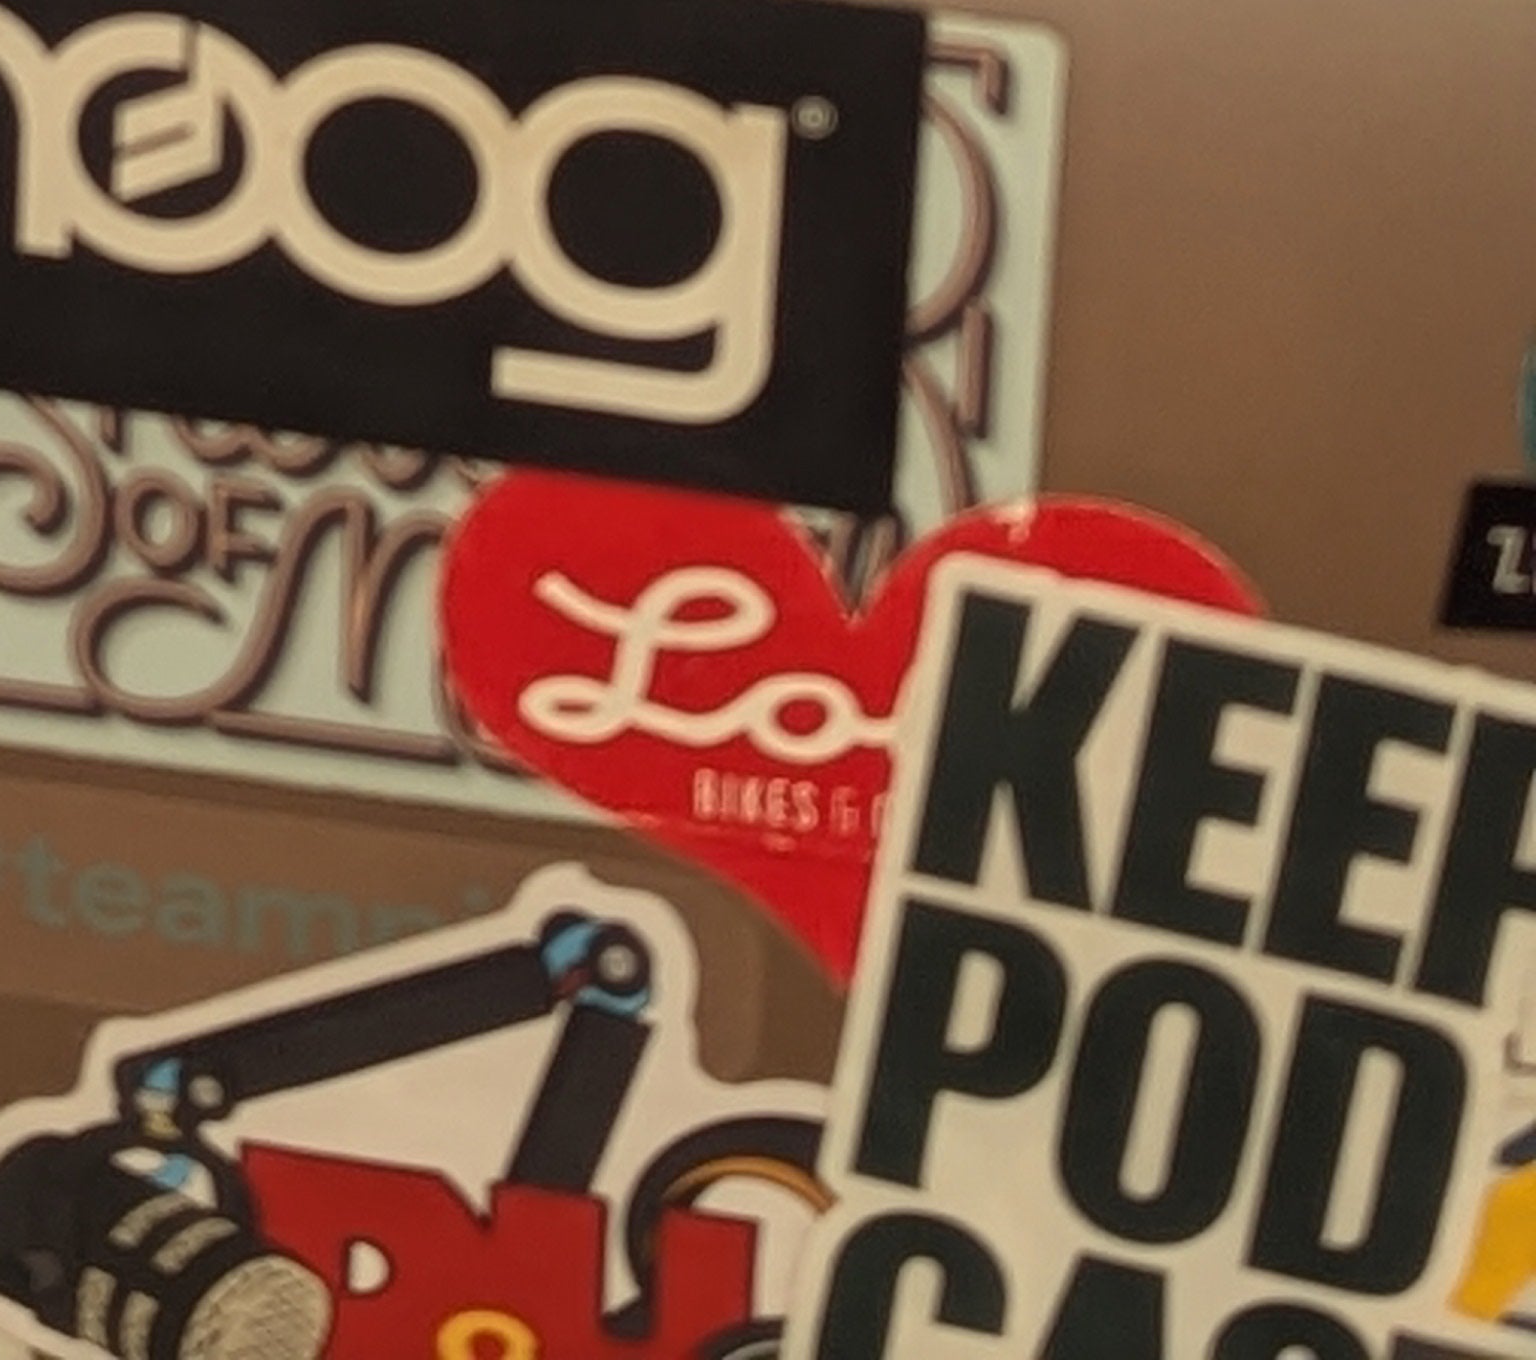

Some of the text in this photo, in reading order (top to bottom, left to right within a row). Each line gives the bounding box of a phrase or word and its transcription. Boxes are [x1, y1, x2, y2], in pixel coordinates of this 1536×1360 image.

[517, 565, 897, 765] Lo
[693, 767, 820, 832] BIKES
[856, 897, 1468, 1298] POD
